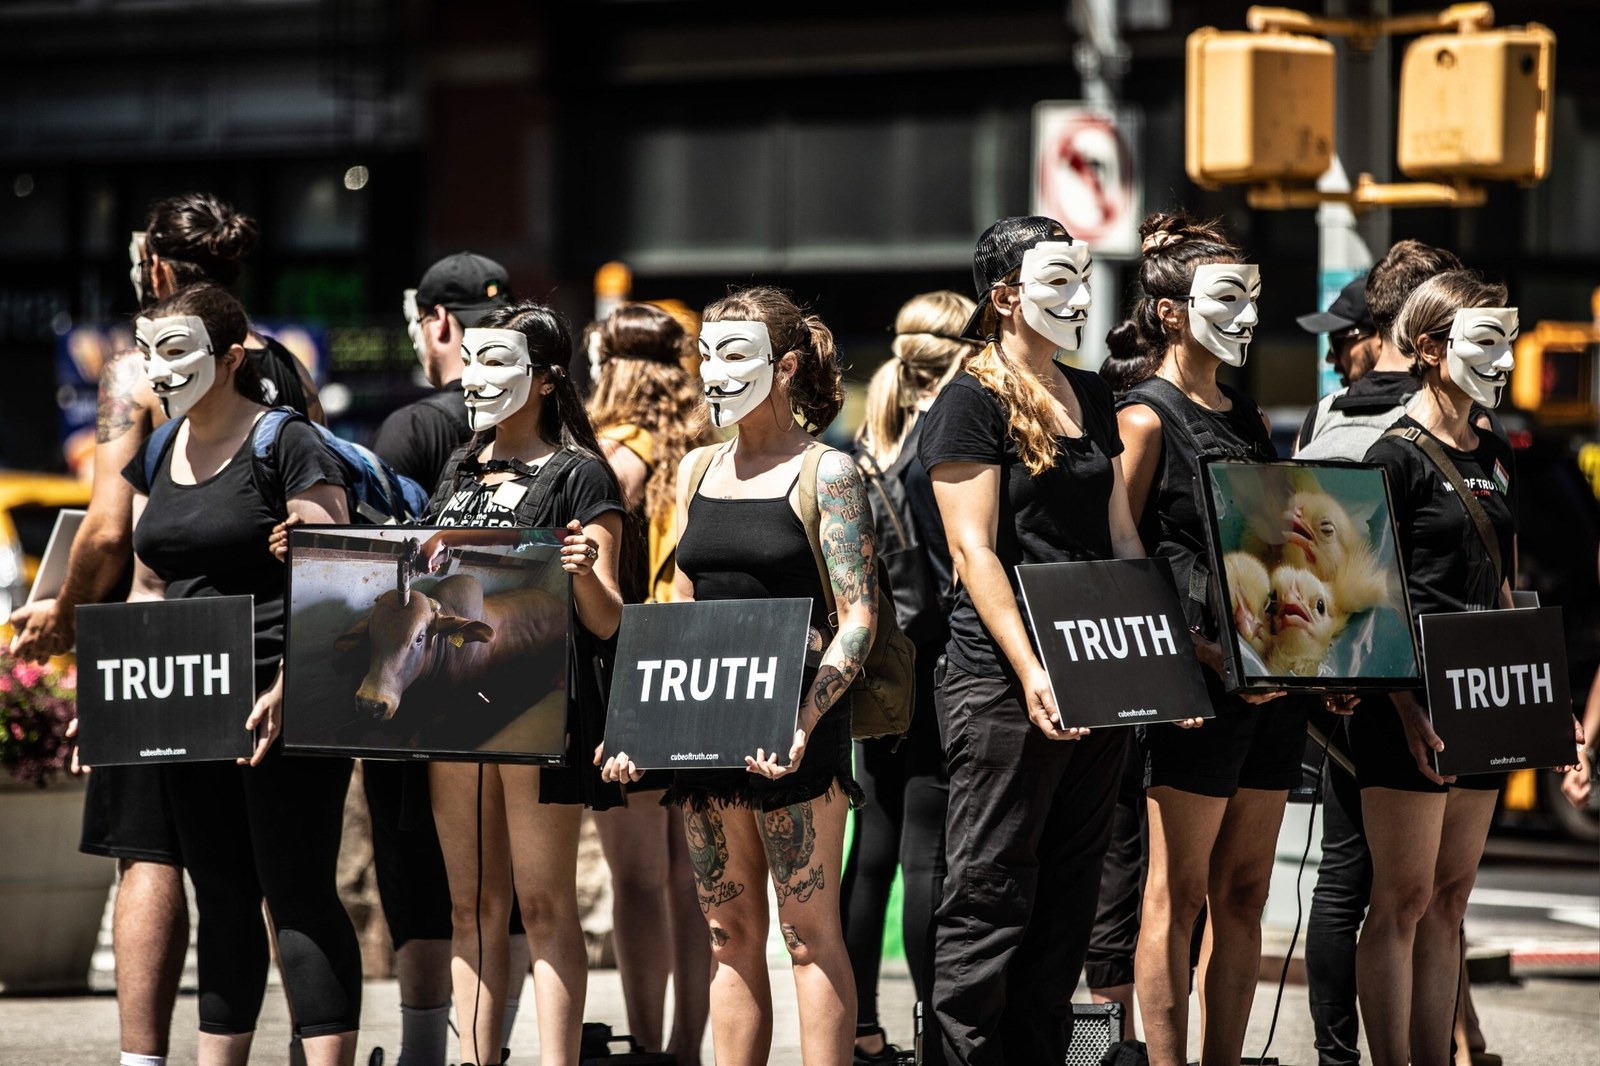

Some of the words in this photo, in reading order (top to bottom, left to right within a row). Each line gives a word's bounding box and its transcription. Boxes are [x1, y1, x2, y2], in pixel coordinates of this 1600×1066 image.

[832, 529, 845, 541] NO
[1053, 614, 1178, 662] TRUTH
[97, 653, 230, 701] TRUTH
[636, 656, 778, 702] TRUTH
[1445, 662, 1554, 710] TRUTH
[1118, 708, 1158, 718] cubeoftruth.com
[139, 747, 187, 757] cubeoftruth.com
[670, 752, 719, 761] cubeoftruth.com
[1489, 756, 1527, 766] cubeoftruth.com
